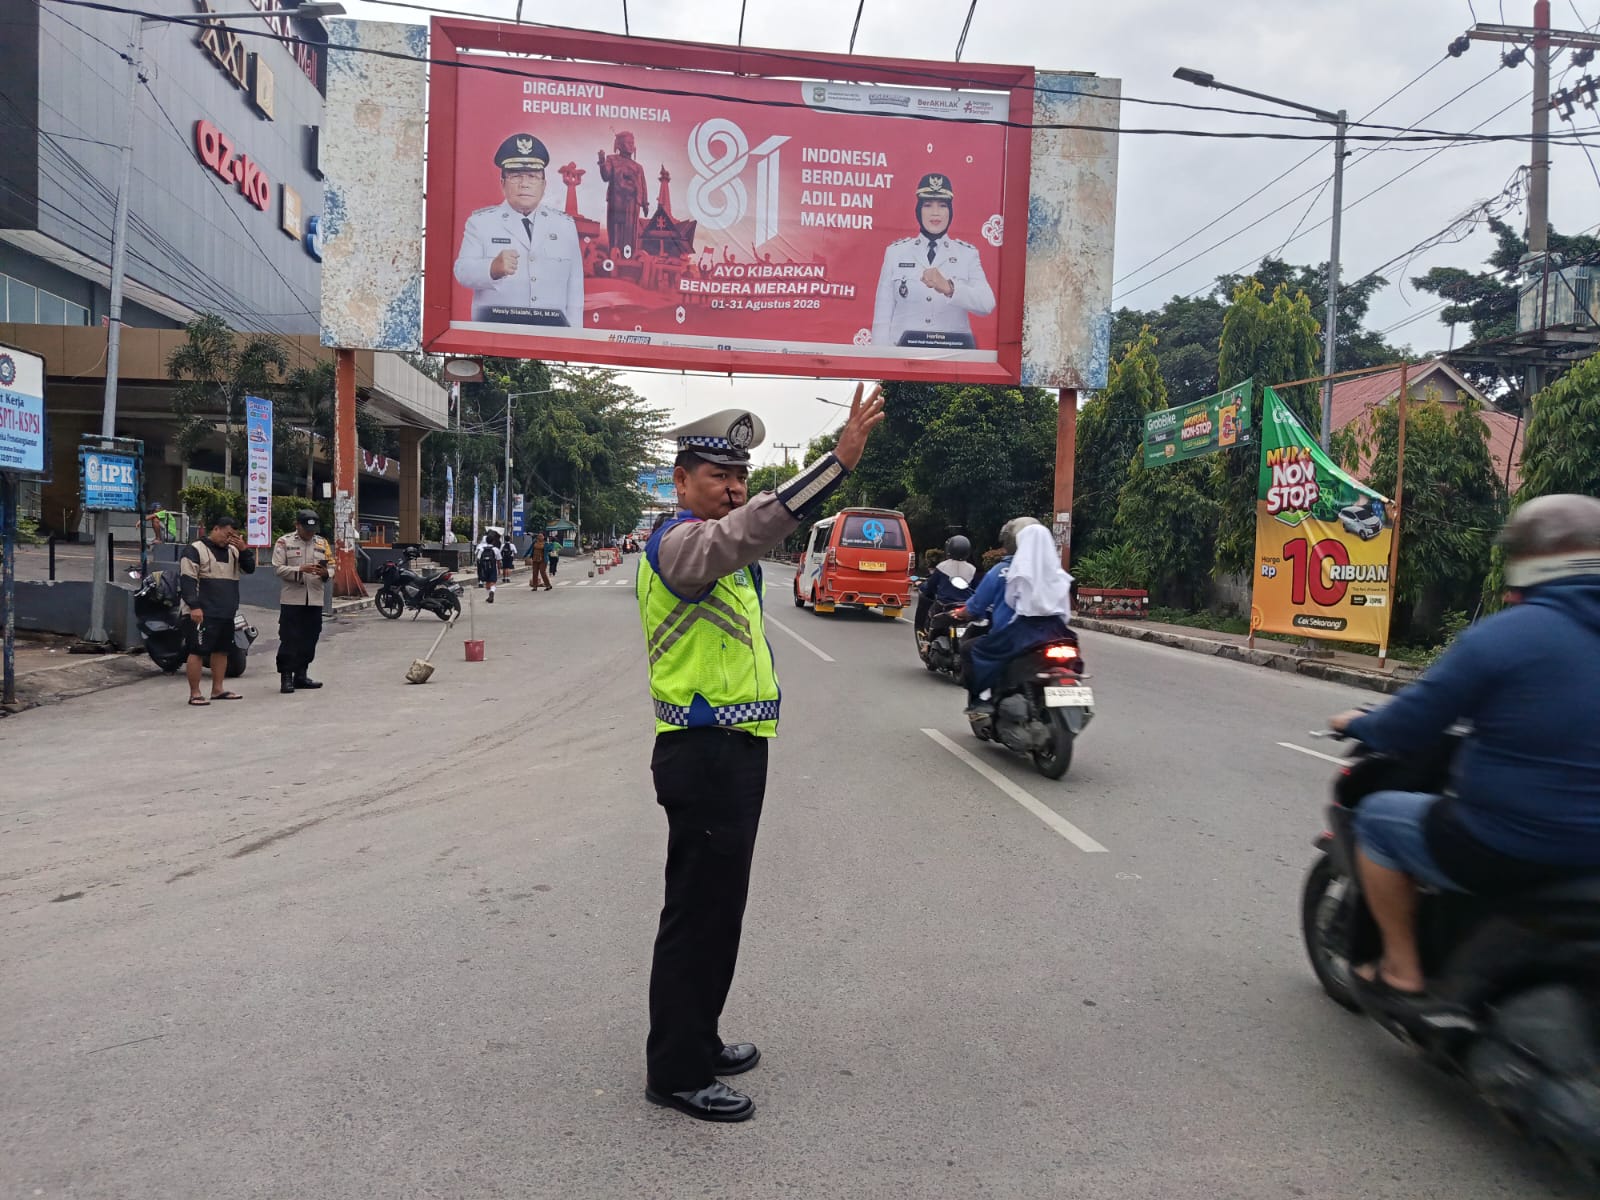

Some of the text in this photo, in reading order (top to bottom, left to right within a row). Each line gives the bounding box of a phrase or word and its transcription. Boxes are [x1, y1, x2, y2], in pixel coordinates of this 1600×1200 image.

[297, 40, 318, 88] Mall
[523, 81, 605, 99] DIRGAHAYU
[522, 99, 671, 123] REPUBLIK INDONESIA
[802, 147, 888, 167] INDONESIA
[687, 117, 793, 249] 81
[801, 169, 894, 189] BERDAULAT
[800, 190, 873, 209] ADIL DAN
[800, 211, 873, 230] MAKMUR
[714, 265, 824, 278] AYO KIBARKAN
[679, 279, 855, 297] BENDERA MERAH PUTIH
[711, 298, 820, 311] 01-31 Agustus 2026
[5, 394, 25, 408] Kerja
[1147, 412, 1177, 431] GrabBike
[1181, 421, 1212, 440] NON-STOP
[101, 463, 133, 484] IPK
[1272, 461, 1315, 487] NON
[1266, 482, 1319, 513] STOP
[1261, 555, 1281, 564] Harga
[1261, 565, 1277, 578] Rp
[1283, 538, 1350, 606] 10
[1329, 565, 1389, 583] RIBUAN
[1297, 616, 1342, 630] Cek Sekarang!
